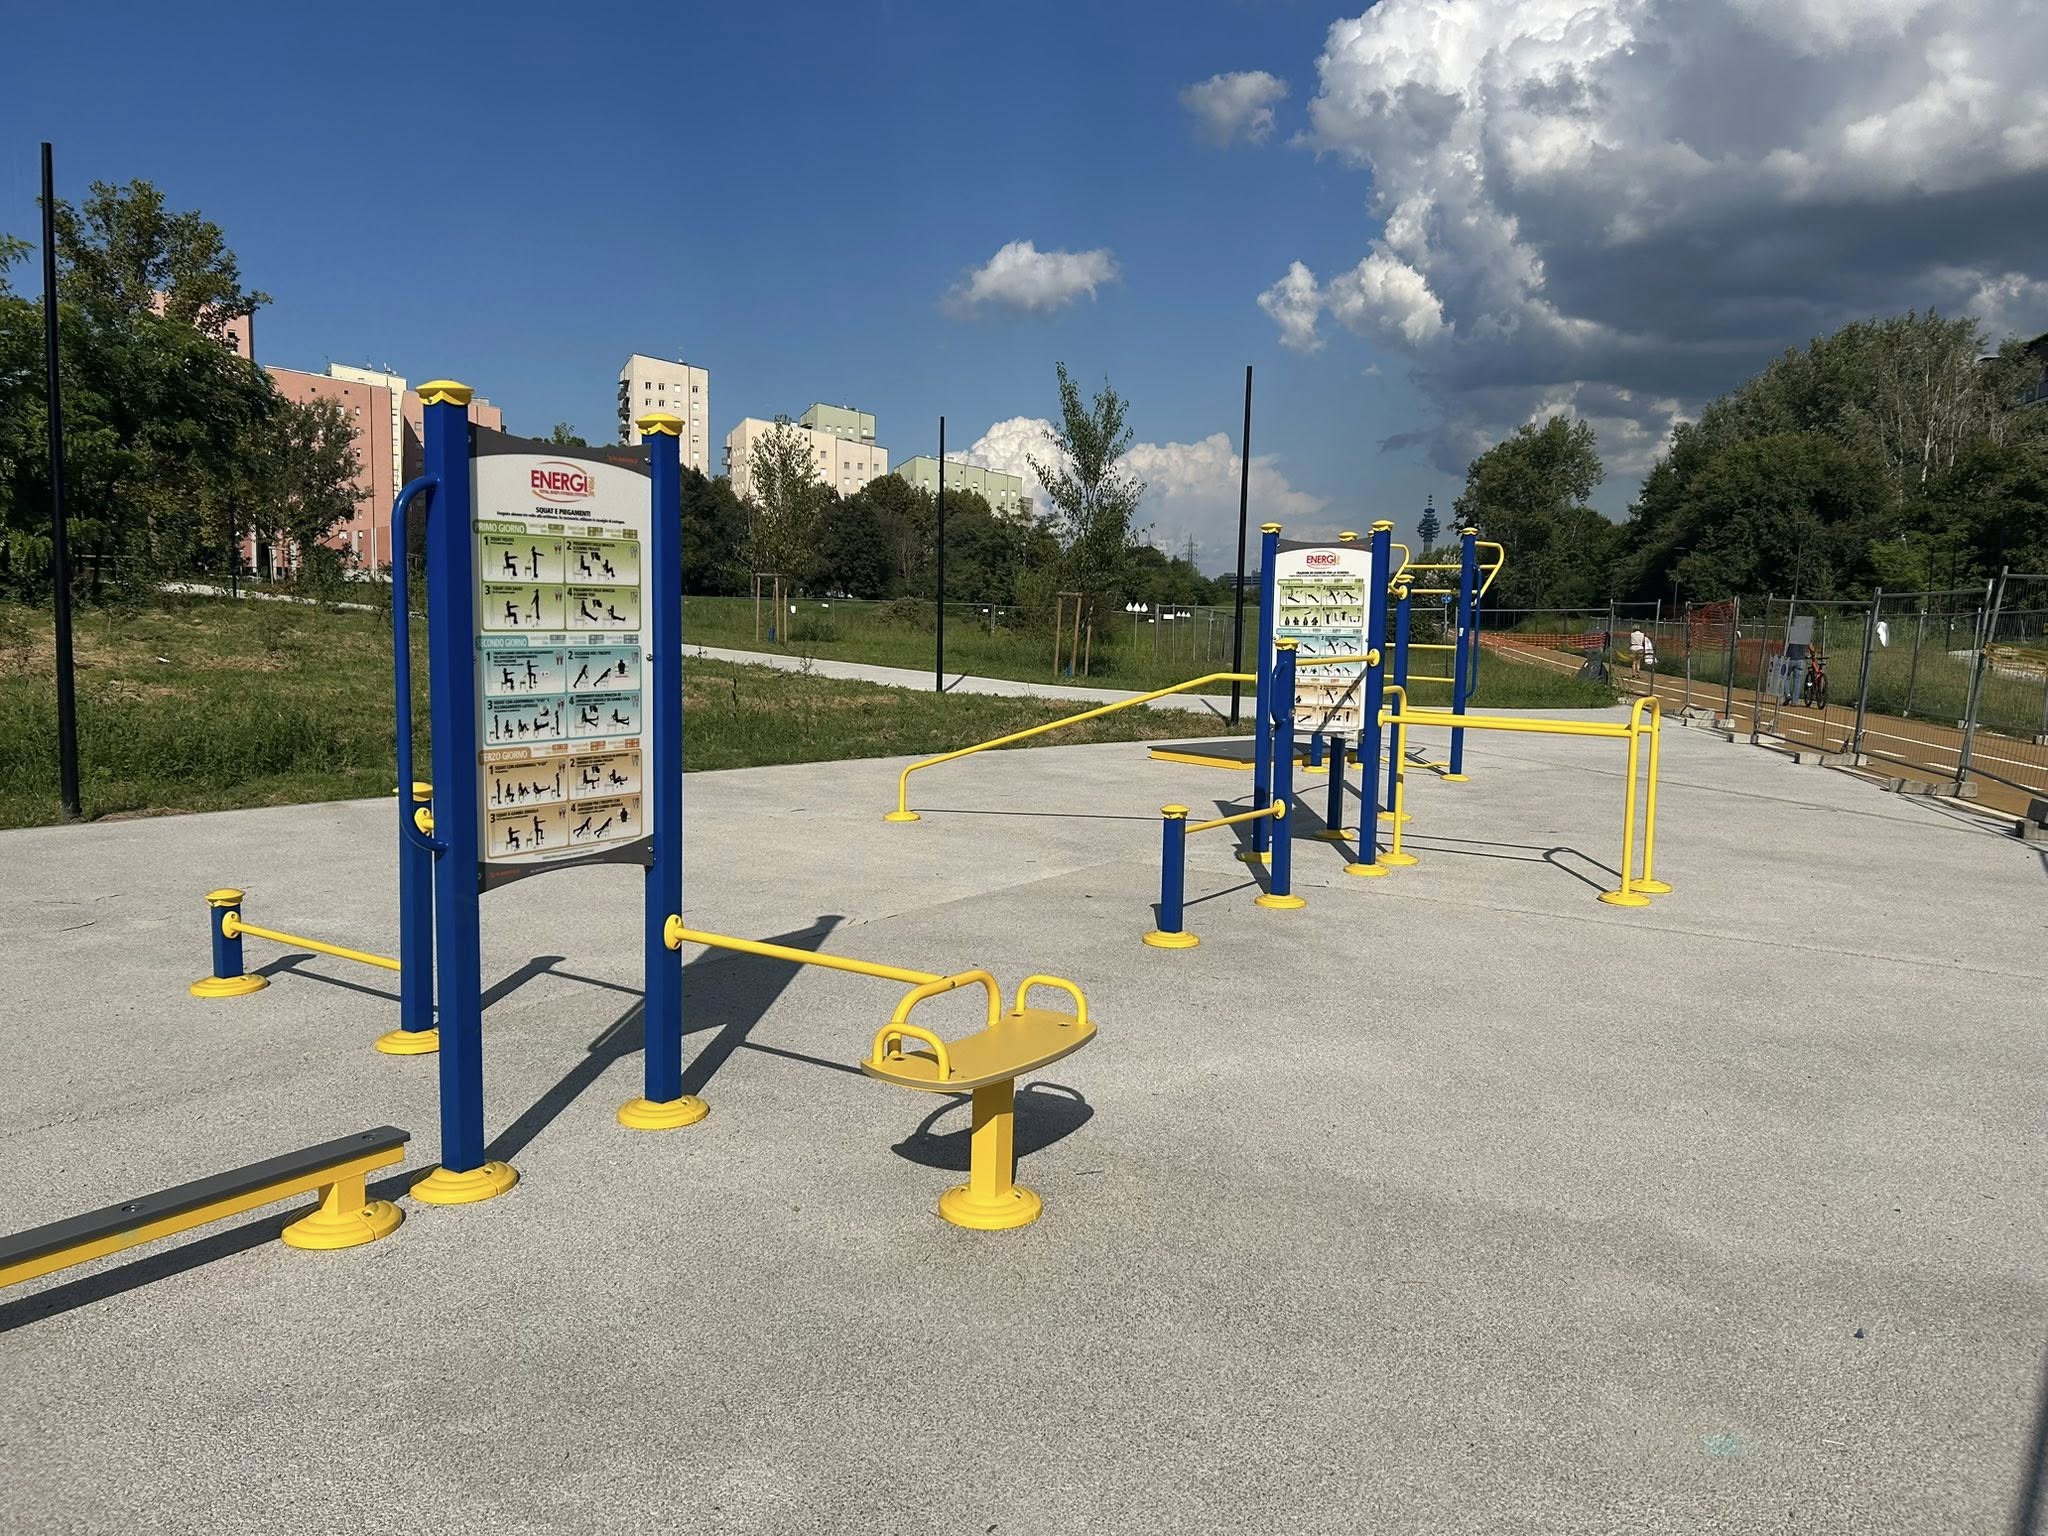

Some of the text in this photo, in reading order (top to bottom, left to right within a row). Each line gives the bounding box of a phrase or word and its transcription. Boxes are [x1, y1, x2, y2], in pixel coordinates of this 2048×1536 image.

[531, 470, 588, 493] ENERGI
[536, 506, 553, 514] SQUAT
[559, 508, 591, 517] PIEGAMENTI
[498, 523, 525, 533] GIORNO
[484, 536, 488, 545] 1
[566, 541, 572, 550] 2
[1306, 555, 1337, 564] ENERGI
[485, 585, 491, 595] 3
[567, 587, 572, 596] 4
[504, 638, 527, 647] GIORNO
[486, 651, 490, 661] 1
[568, 651, 573, 660] 2
[487, 700, 493, 710] 3
[569, 696, 574, 705] 4
[502, 750, 528, 760] GIORNO
[570, 759, 575, 767] 2
[489, 765, 493, 775] 1
[571, 803, 576, 812] 4
[490, 813, 496, 823] 3
